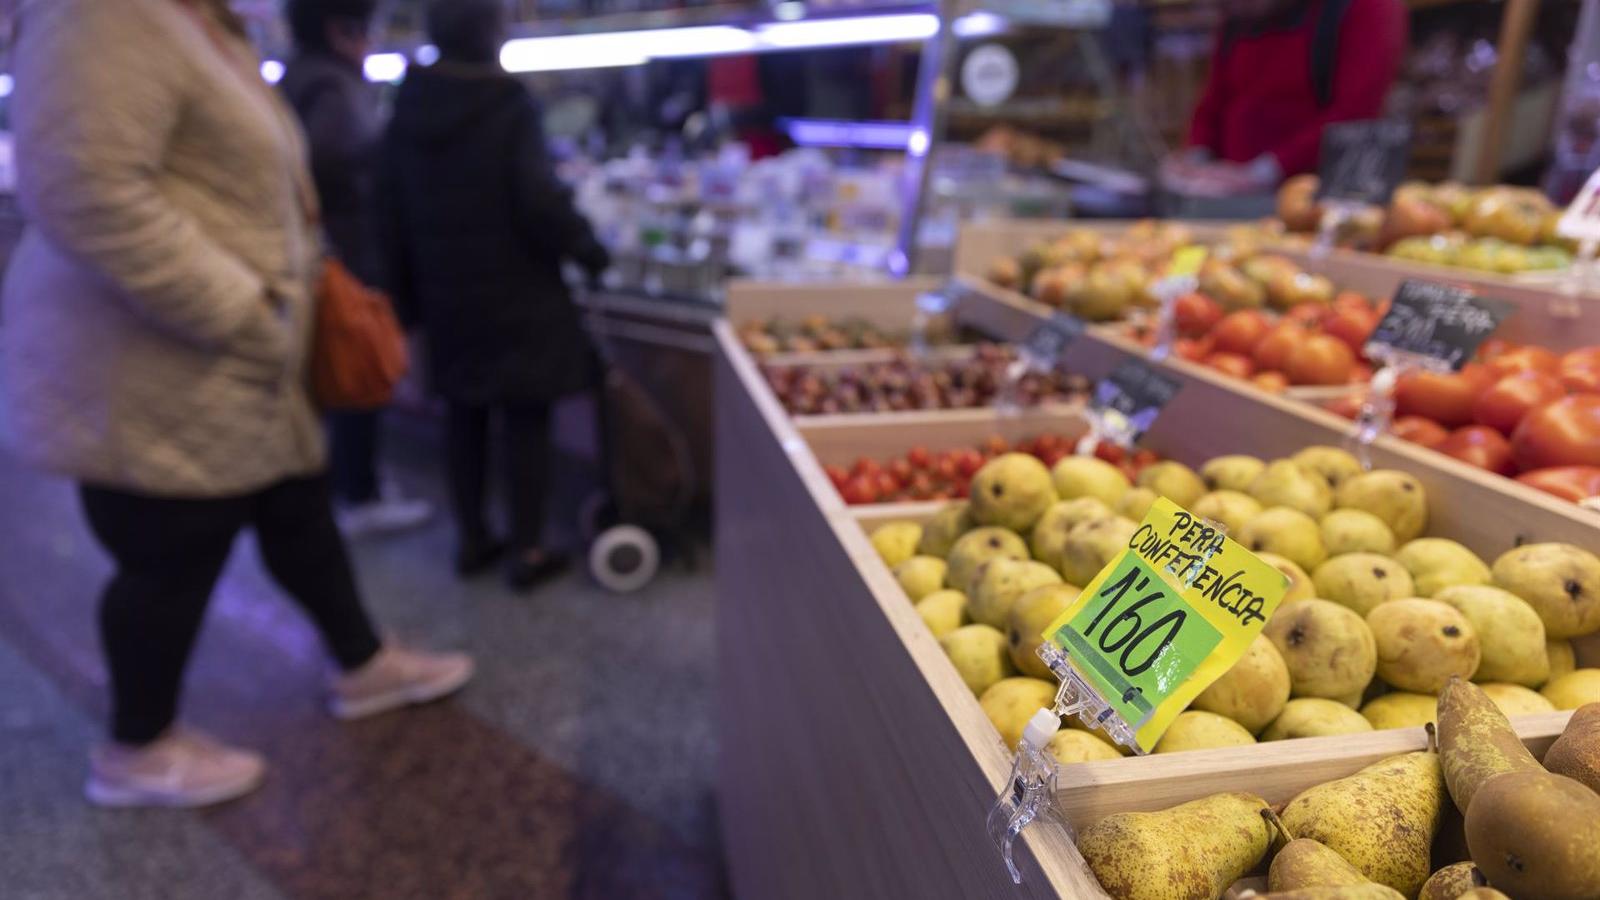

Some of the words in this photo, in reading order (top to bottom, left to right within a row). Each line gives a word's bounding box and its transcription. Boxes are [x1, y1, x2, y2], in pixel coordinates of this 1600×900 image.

[1128, 524, 1266, 626] CONFERENCIA
[1168, 511, 1226, 555] PERA
[1083, 566, 1187, 677] 1'60
